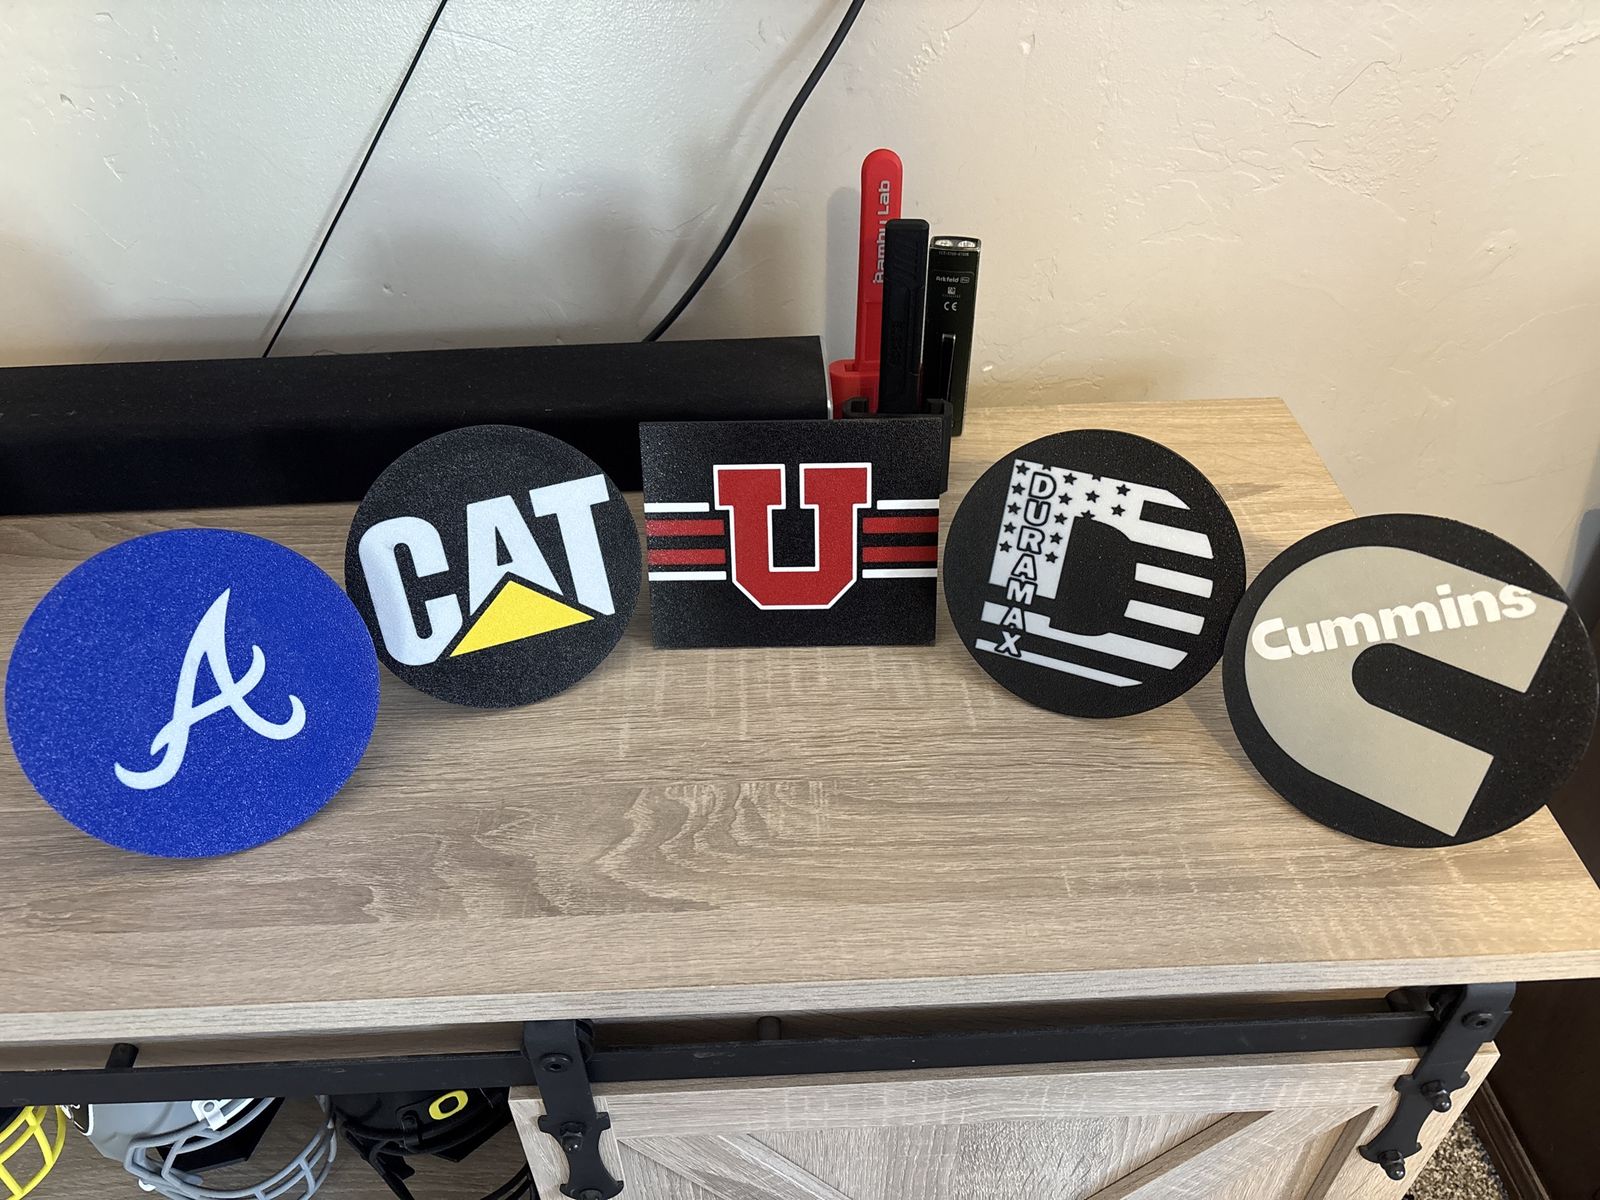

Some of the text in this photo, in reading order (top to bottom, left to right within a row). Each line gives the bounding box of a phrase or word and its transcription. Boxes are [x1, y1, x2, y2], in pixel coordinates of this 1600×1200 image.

[877, 180, 891, 216] Lab
[943, 301, 958, 312] CE
[358, 473, 615, 666] CAT
[713, 462, 872, 610] U
[995, 471, 1057, 657] DURAMAX
[113, 587, 306, 790] A
[1251, 583, 1537, 661] Cummins
